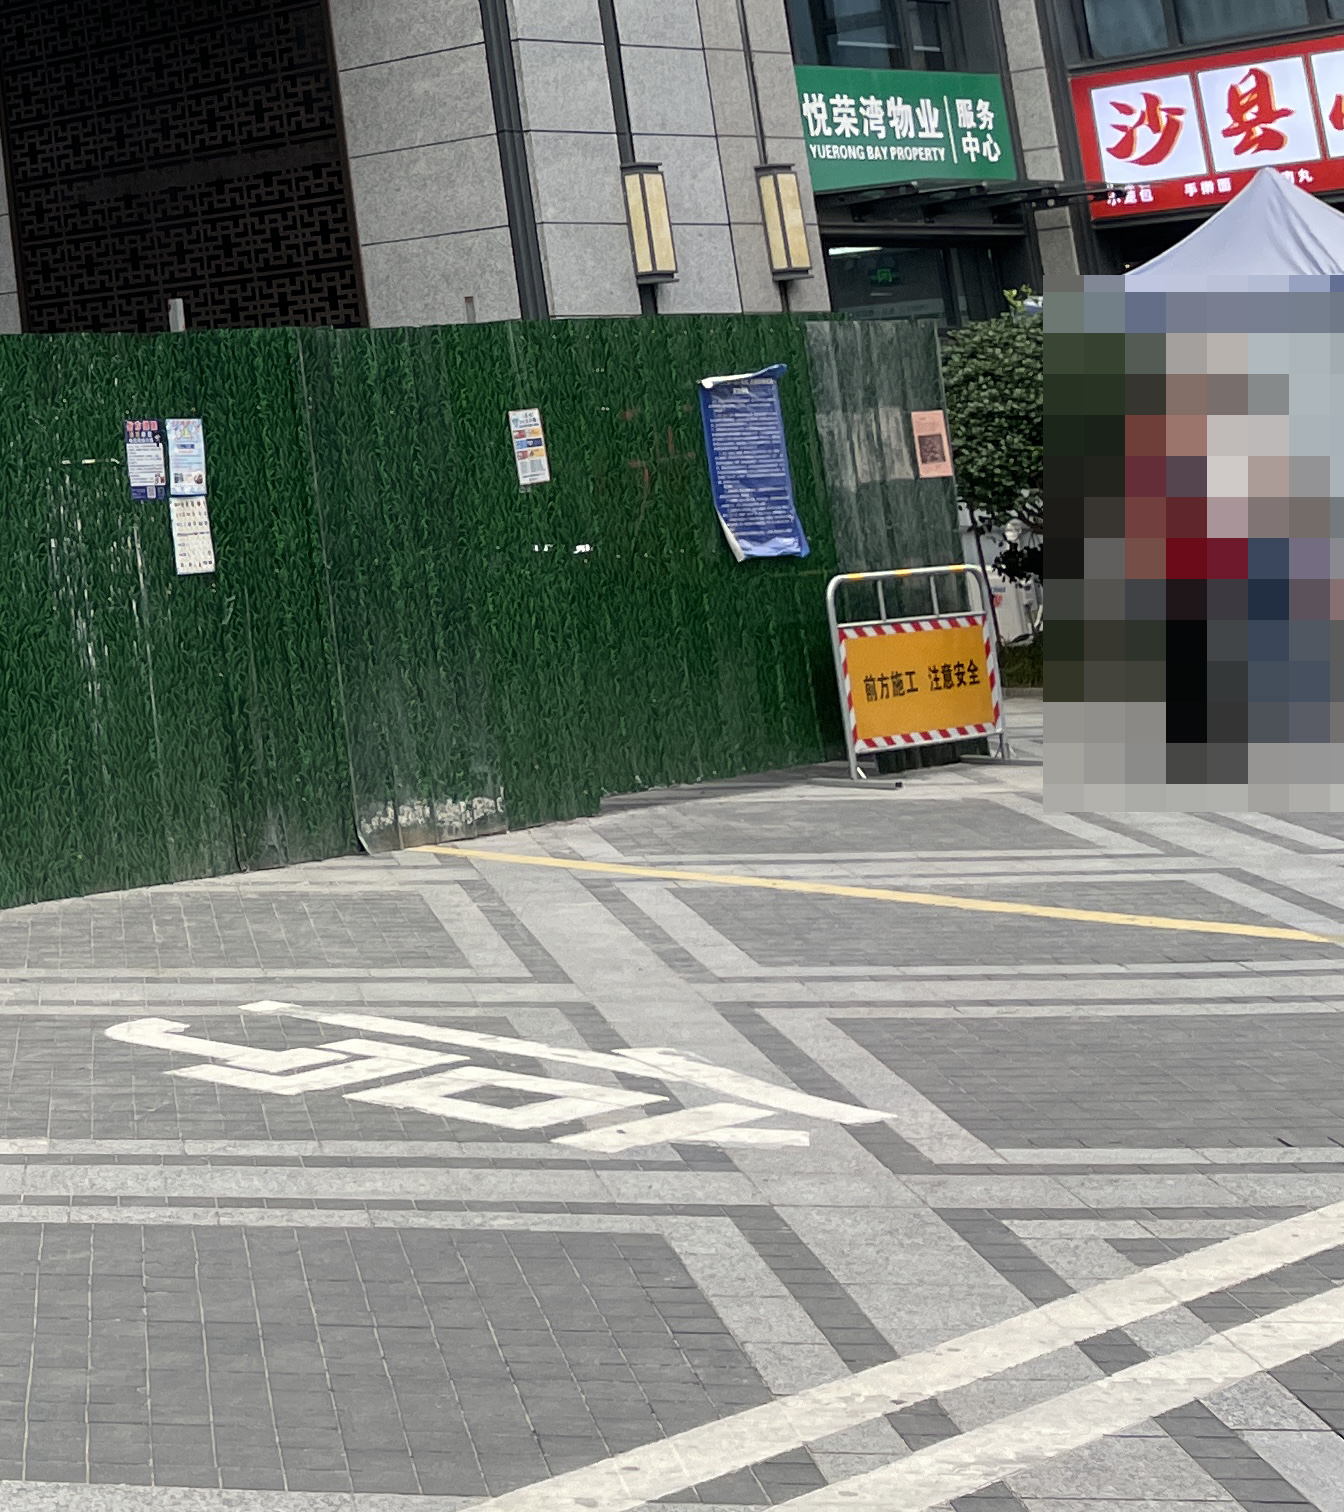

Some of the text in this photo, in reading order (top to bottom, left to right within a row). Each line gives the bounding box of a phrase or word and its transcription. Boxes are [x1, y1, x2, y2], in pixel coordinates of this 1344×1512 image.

[802, 92, 944, 140] 悦荣湾物业
[955, 98, 995, 130] 服务
[1106, 67, 1344, 166] 沙县
[809, 144, 946, 162] YUERONG BAY PROPERTY
[961, 131, 1002, 163] 中心
[863, 658, 981, 703] 前方施工 注意安全
